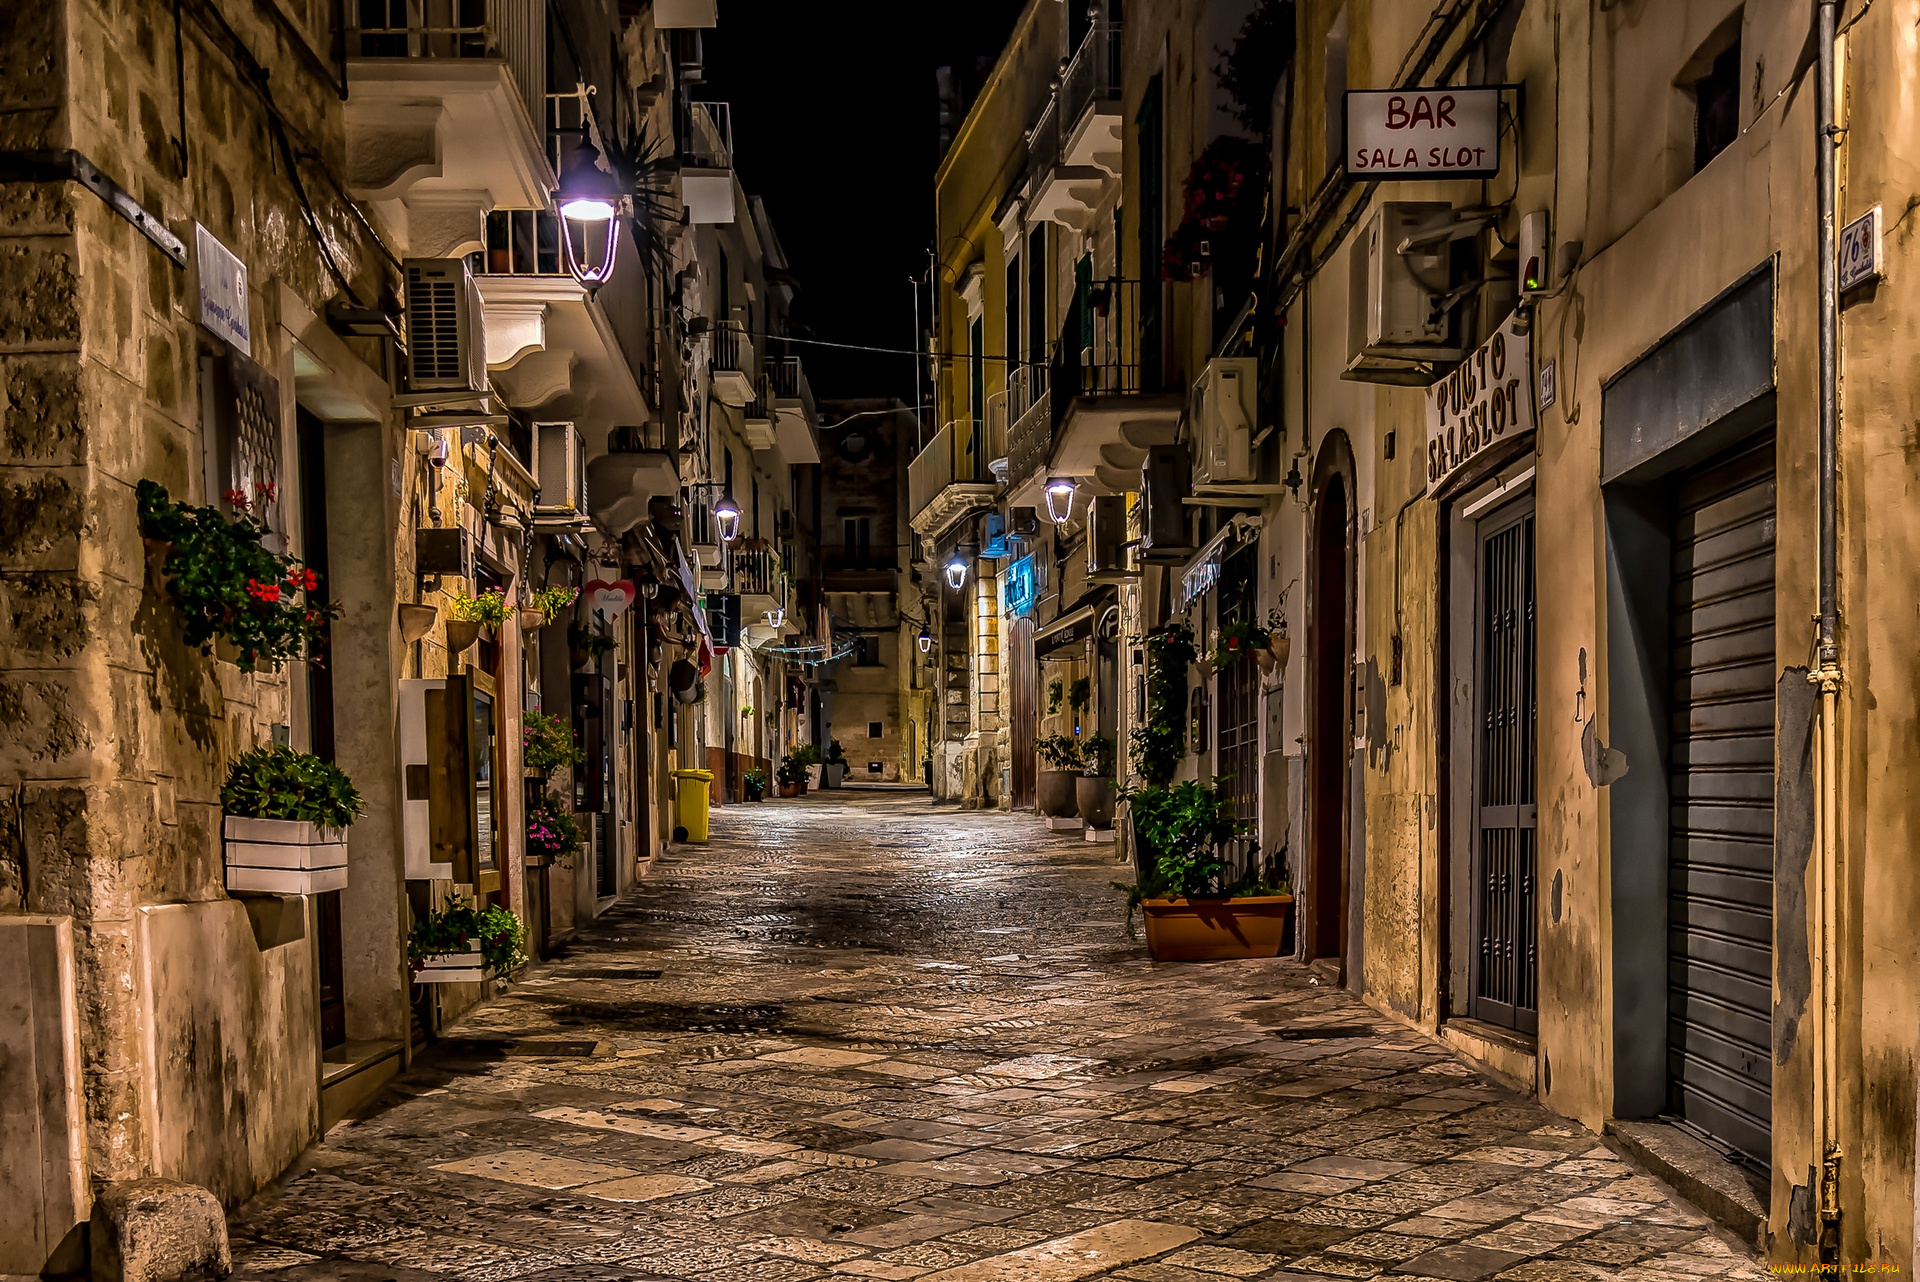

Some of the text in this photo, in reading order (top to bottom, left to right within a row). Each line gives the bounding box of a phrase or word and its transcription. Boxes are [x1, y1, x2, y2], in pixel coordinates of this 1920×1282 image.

[1385, 95, 1457, 130] BAR
[1355, 146, 1486, 168] SALA SLOT
[1843, 227, 1860, 269] 76
[1436, 331, 1506, 428] PUNTO
